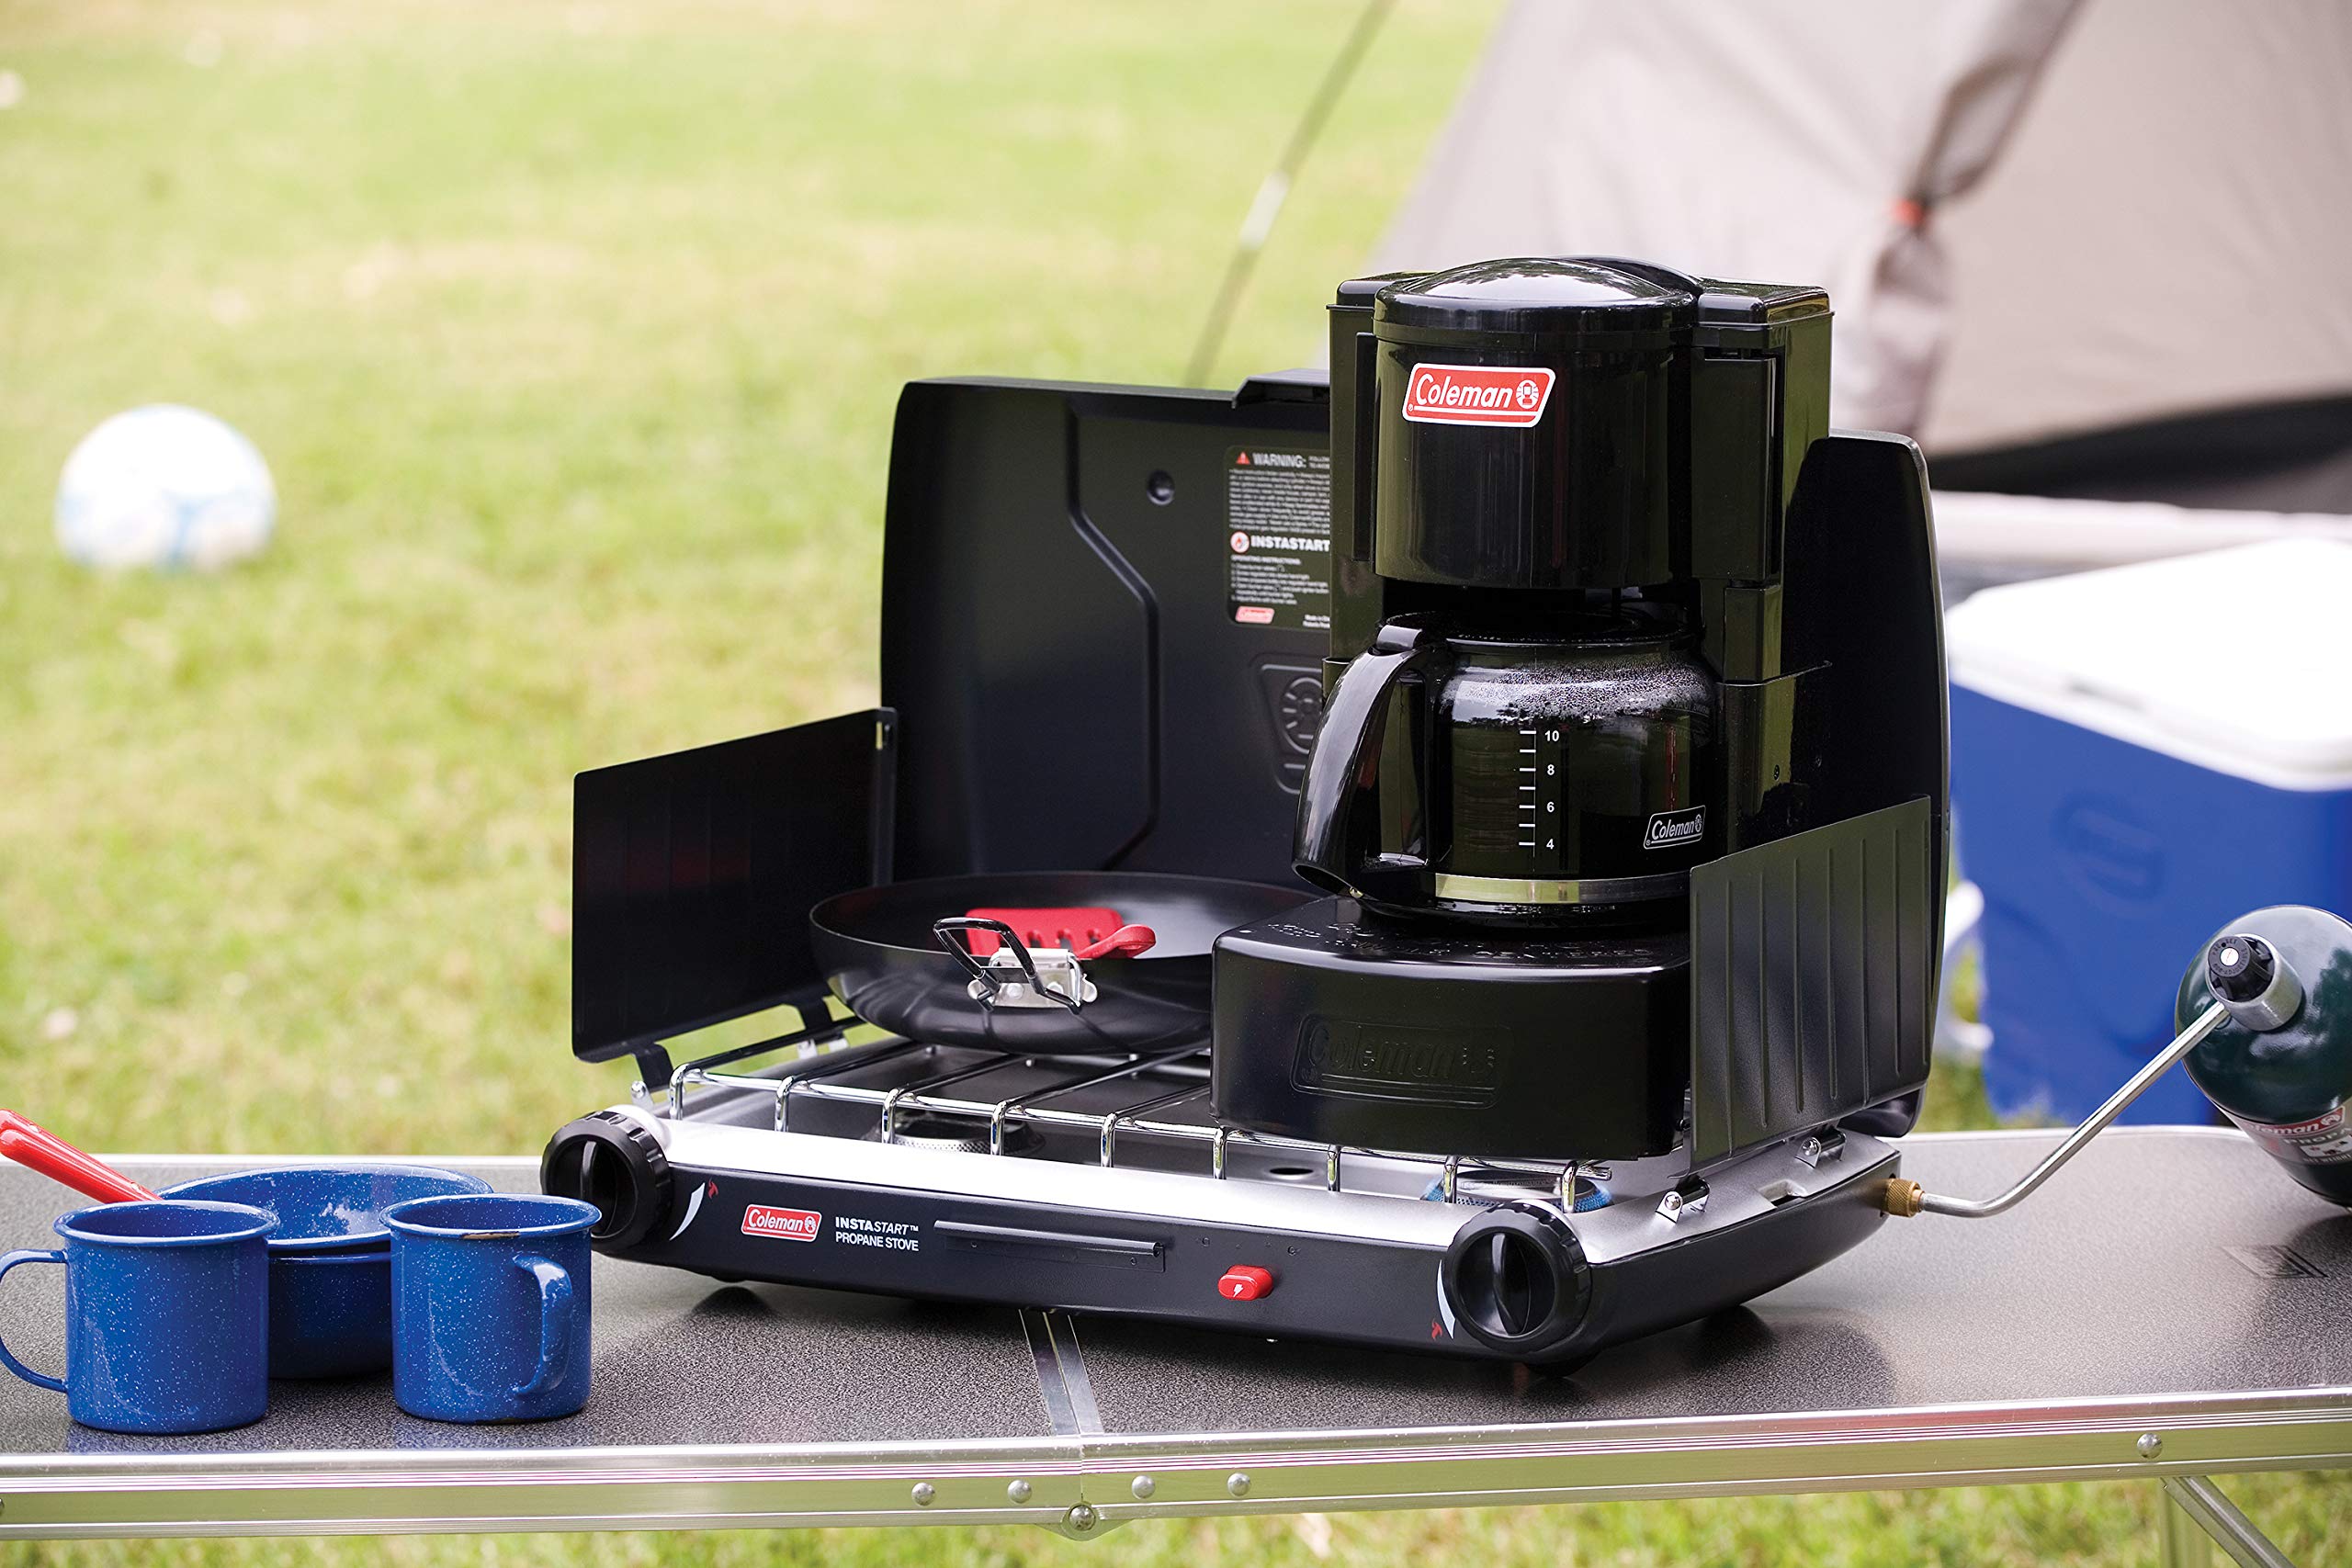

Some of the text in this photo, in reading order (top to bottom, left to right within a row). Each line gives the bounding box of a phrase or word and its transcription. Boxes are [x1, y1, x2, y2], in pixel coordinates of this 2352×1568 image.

[1416, 373, 1513, 408] Coleman
[1252, 453, 1306, 468] WARNING:
[1250, 535, 1330, 552] INSTASTART
[1544, 730, 1560, 742] 10
[1546, 763, 1555, 776] 8
[1546, 801, 1555, 813] 6
[1651, 818, 1695, 840] Coleman
[1545, 838, 1555, 850] 4
[748, 1209, 805, 1233] Coleman
[835, 1231, 919, 1251] PROPANE STOVE
